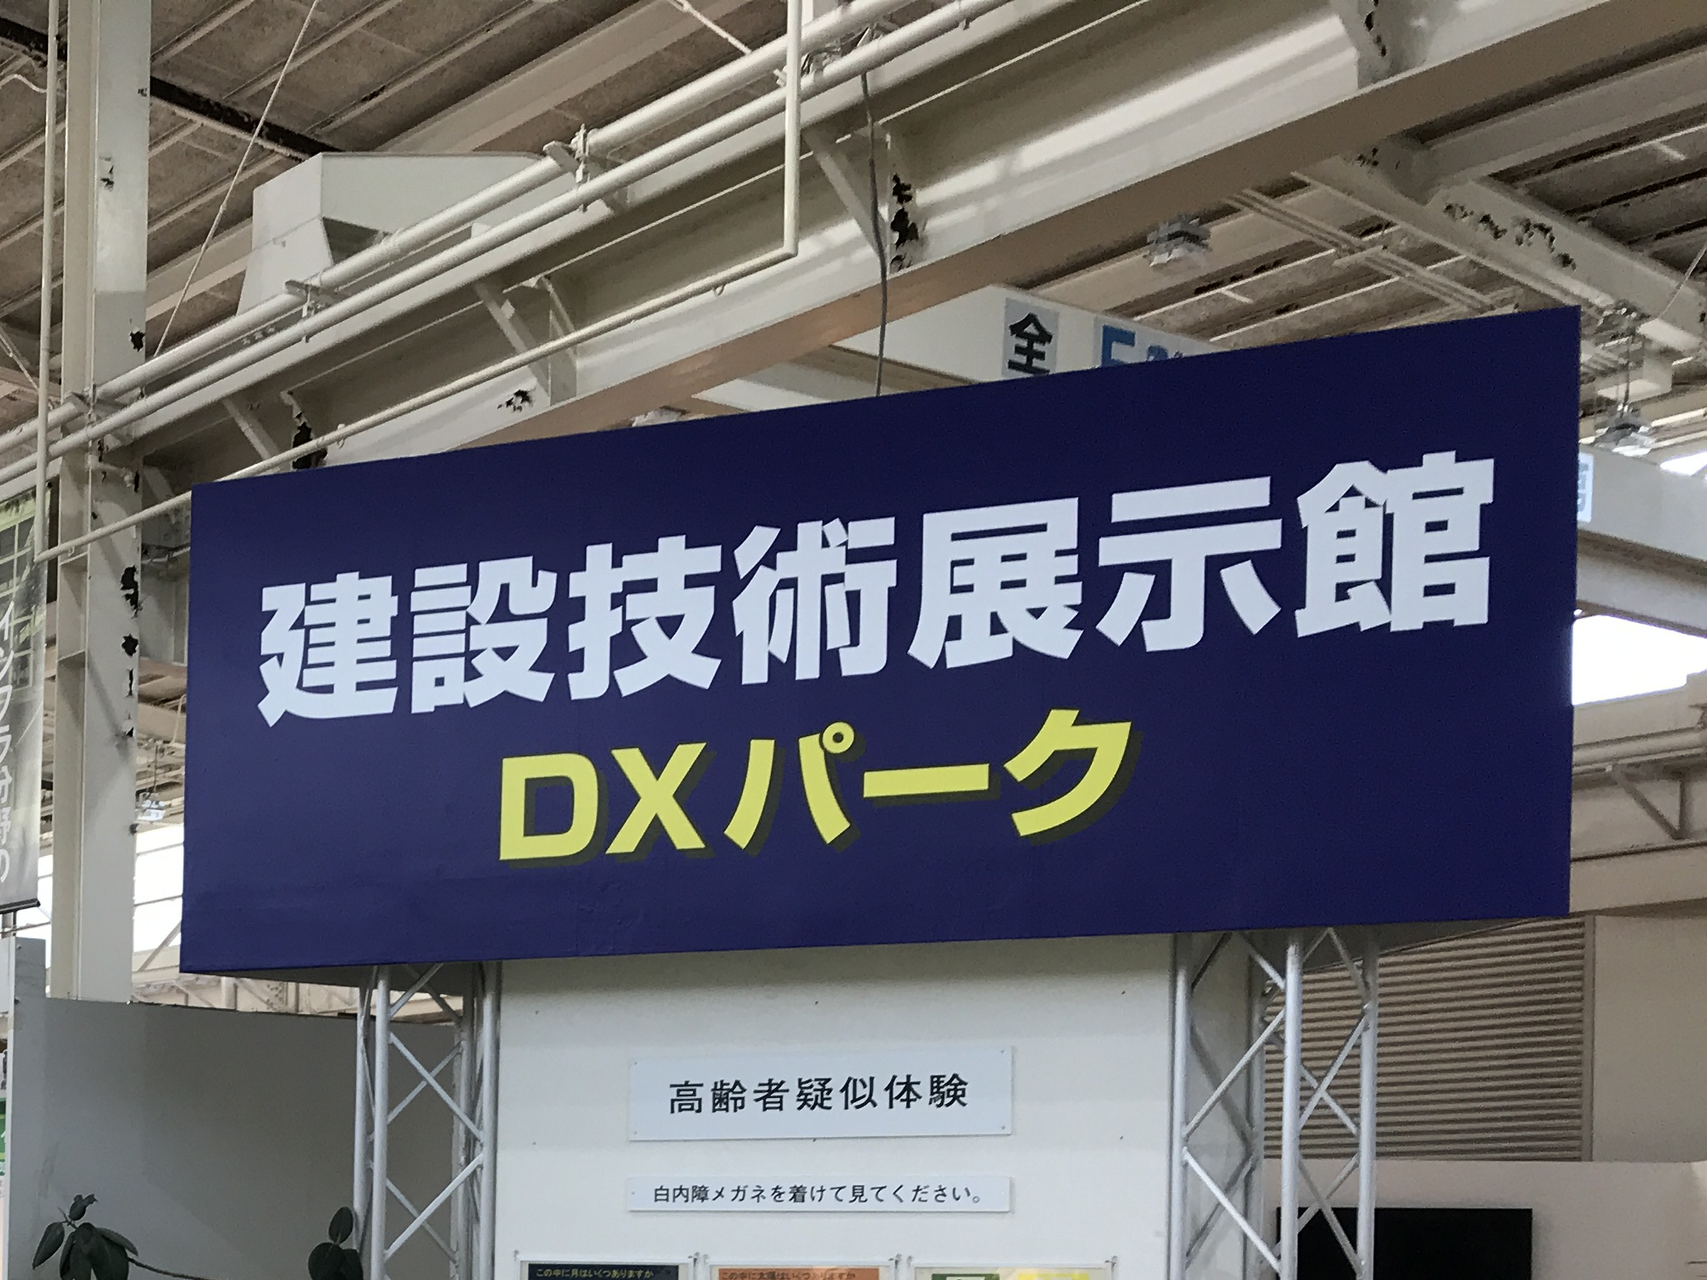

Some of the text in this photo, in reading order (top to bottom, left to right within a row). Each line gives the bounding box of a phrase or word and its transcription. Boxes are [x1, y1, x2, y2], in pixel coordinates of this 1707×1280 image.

[1007, 312, 1054, 376] 全
[257, 451, 1495, 727] 建設技術展示館
[498, 708, 1134, 861] DXパーク
[669, 1073, 970, 1115] 高齢者疑似体験
[653, 1184, 982, 1204] 白内障メガネを着けて見てください。
[535, 1268, 654, 1279] この中に月はいくつありますか
